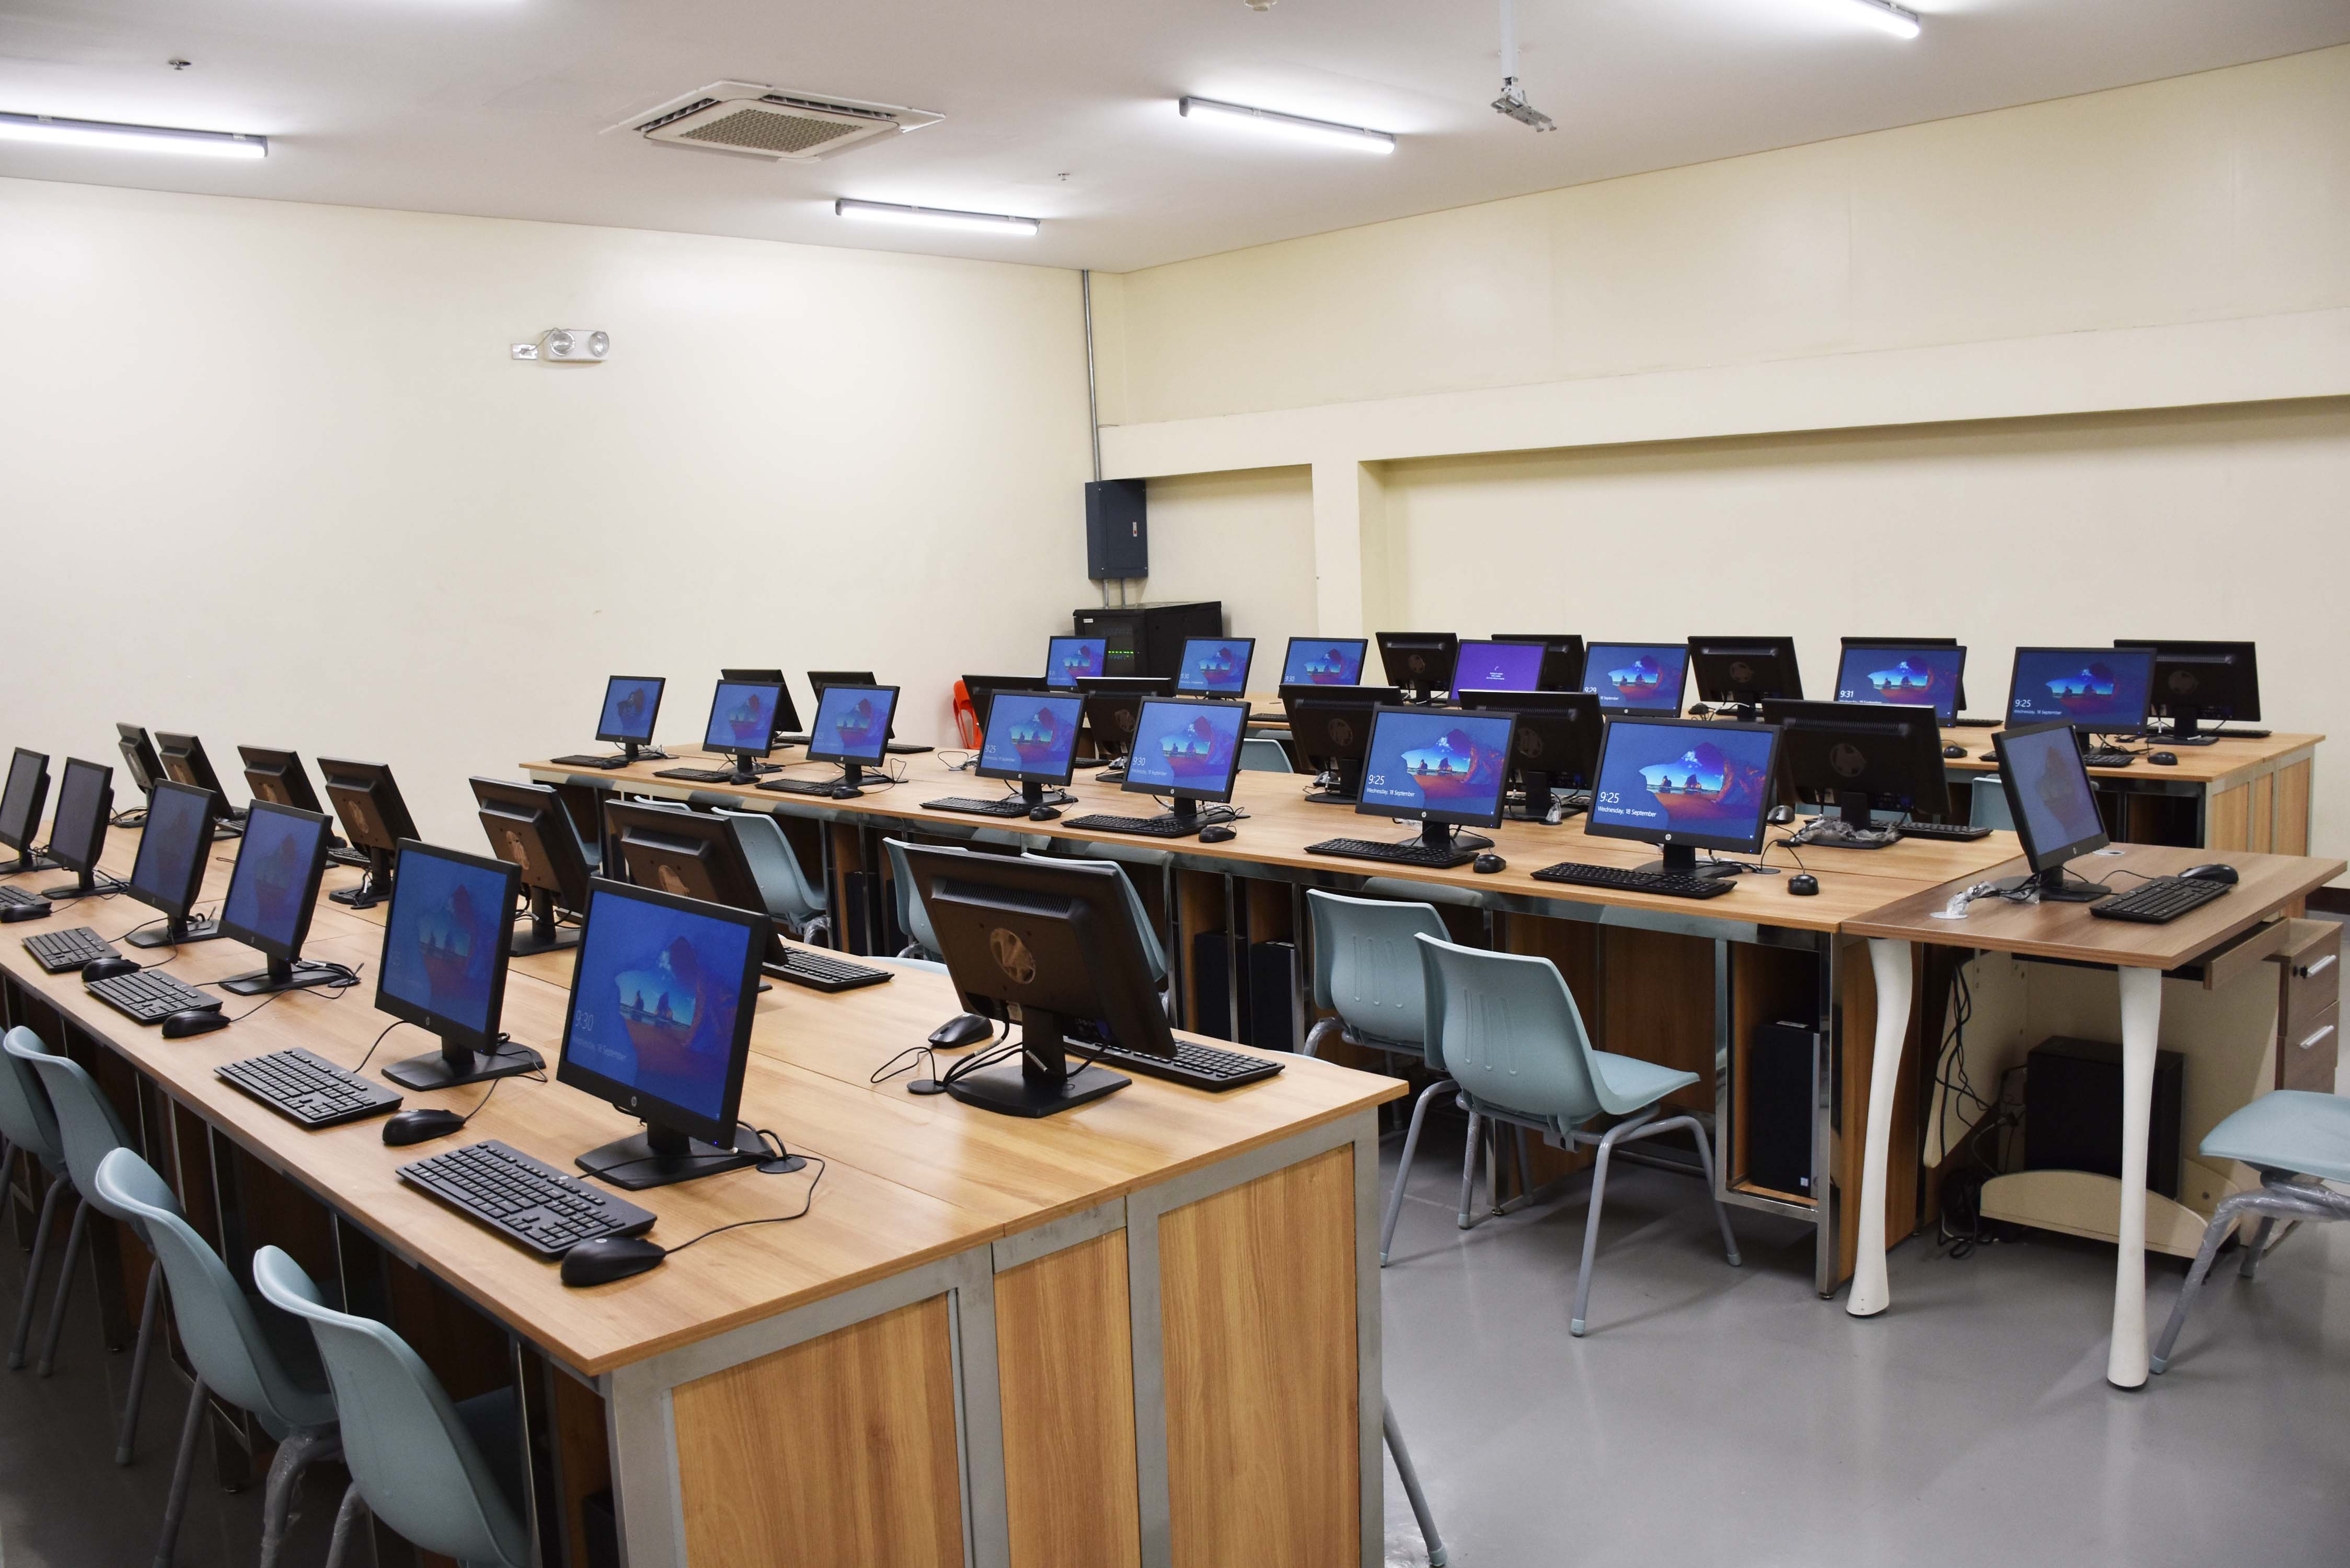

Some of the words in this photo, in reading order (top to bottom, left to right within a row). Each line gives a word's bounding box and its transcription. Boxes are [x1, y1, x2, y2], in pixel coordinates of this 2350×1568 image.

[1840, 690, 1854, 698] 9:31
[2015, 699, 2031, 708] 9:25
[1133, 756, 1146, 766] 9:30
[1368, 774, 1385, 785] 9:25
[1366, 788, 1389, 796] Wednesday,
[1599, 791, 1620, 803] 9:25
[1597, 805, 1624, 815] Wednesday,
[1631, 809, 1657, 817] September
[575, 1009, 594, 1032] 9:30
